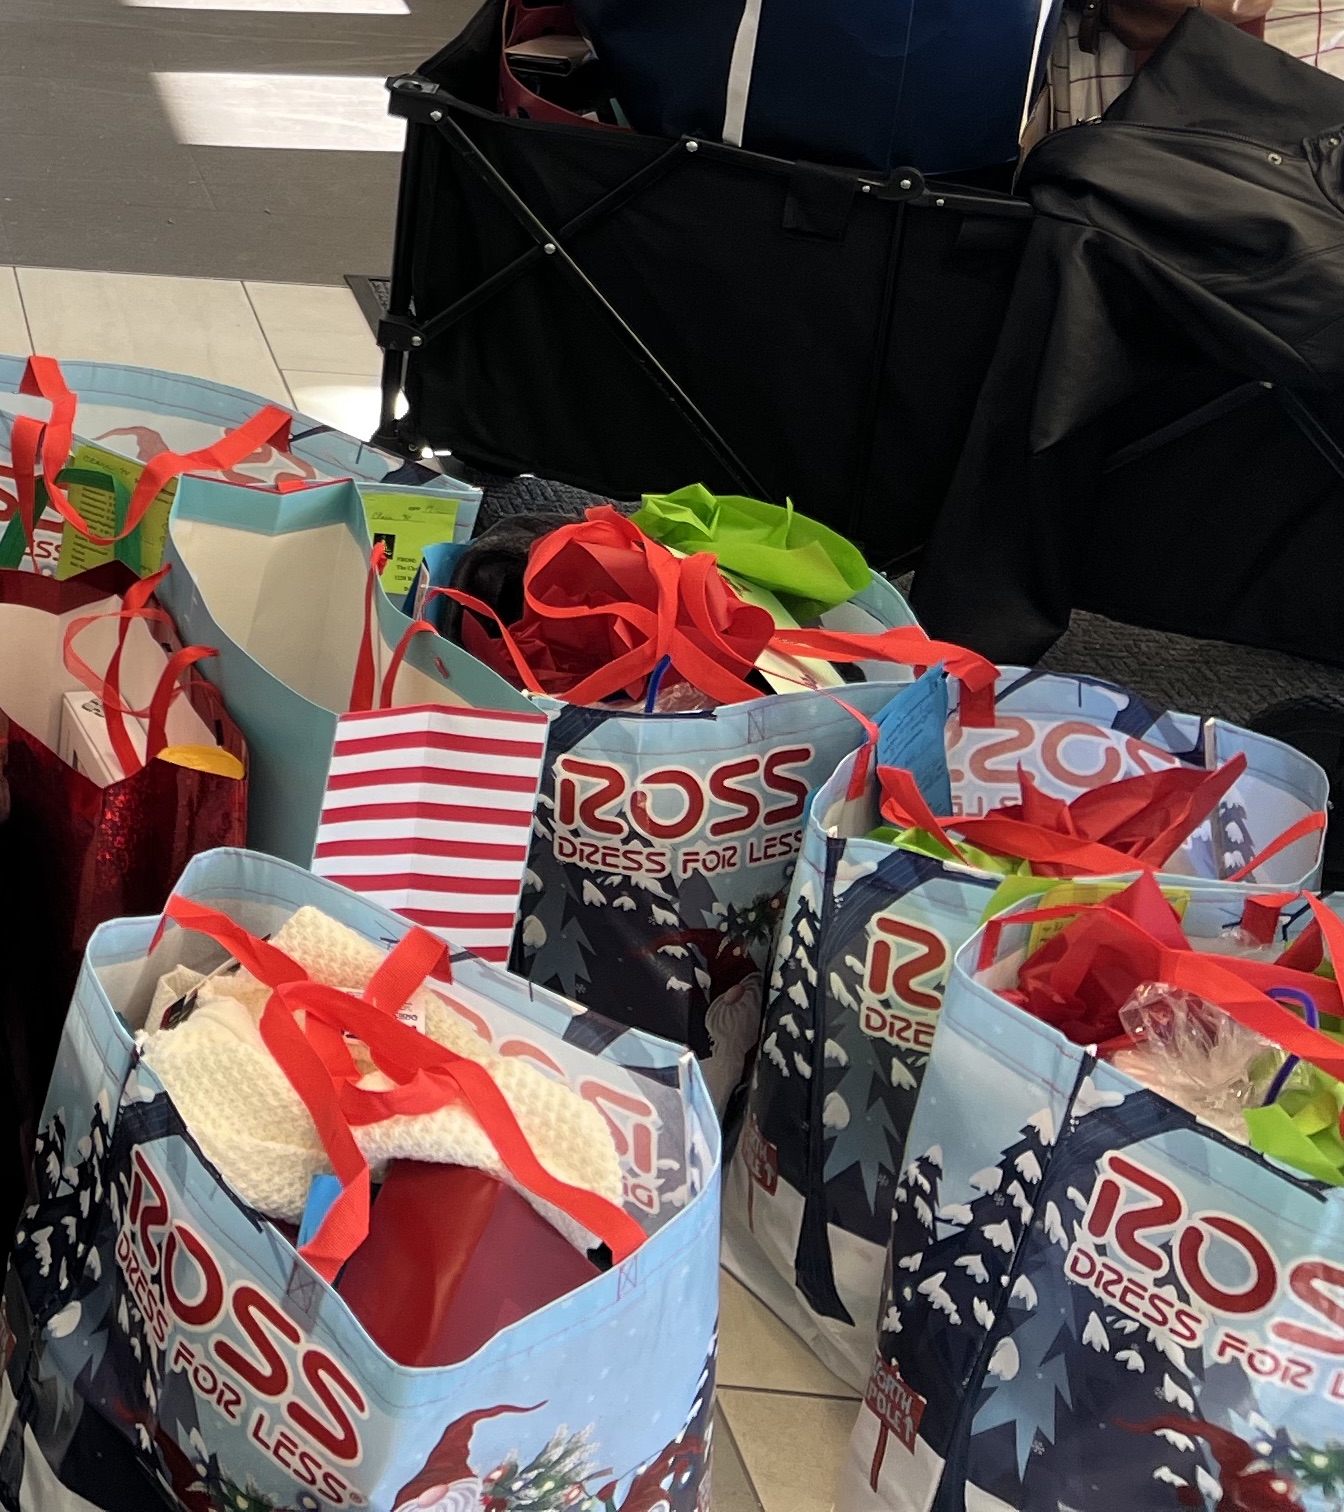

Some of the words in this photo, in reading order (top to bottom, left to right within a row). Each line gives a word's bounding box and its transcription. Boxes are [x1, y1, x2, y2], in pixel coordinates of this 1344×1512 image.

[558, 835, 667, 874] DRESS
[681, 845, 738, 875] FOR
[559, 747, 811, 840] ROSS
[865, 1006, 936, 1048] DRE
[116, 1230, 169, 1345] DRESS
[173, 1340, 243, 1420] FOR
[129, 1148, 366, 1462] ROSS
[1069, 1247, 1203, 1342] DRESS
[1217, 1332, 1316, 1390] FOR
[1088, 1155, 1344, 1356] ROS
